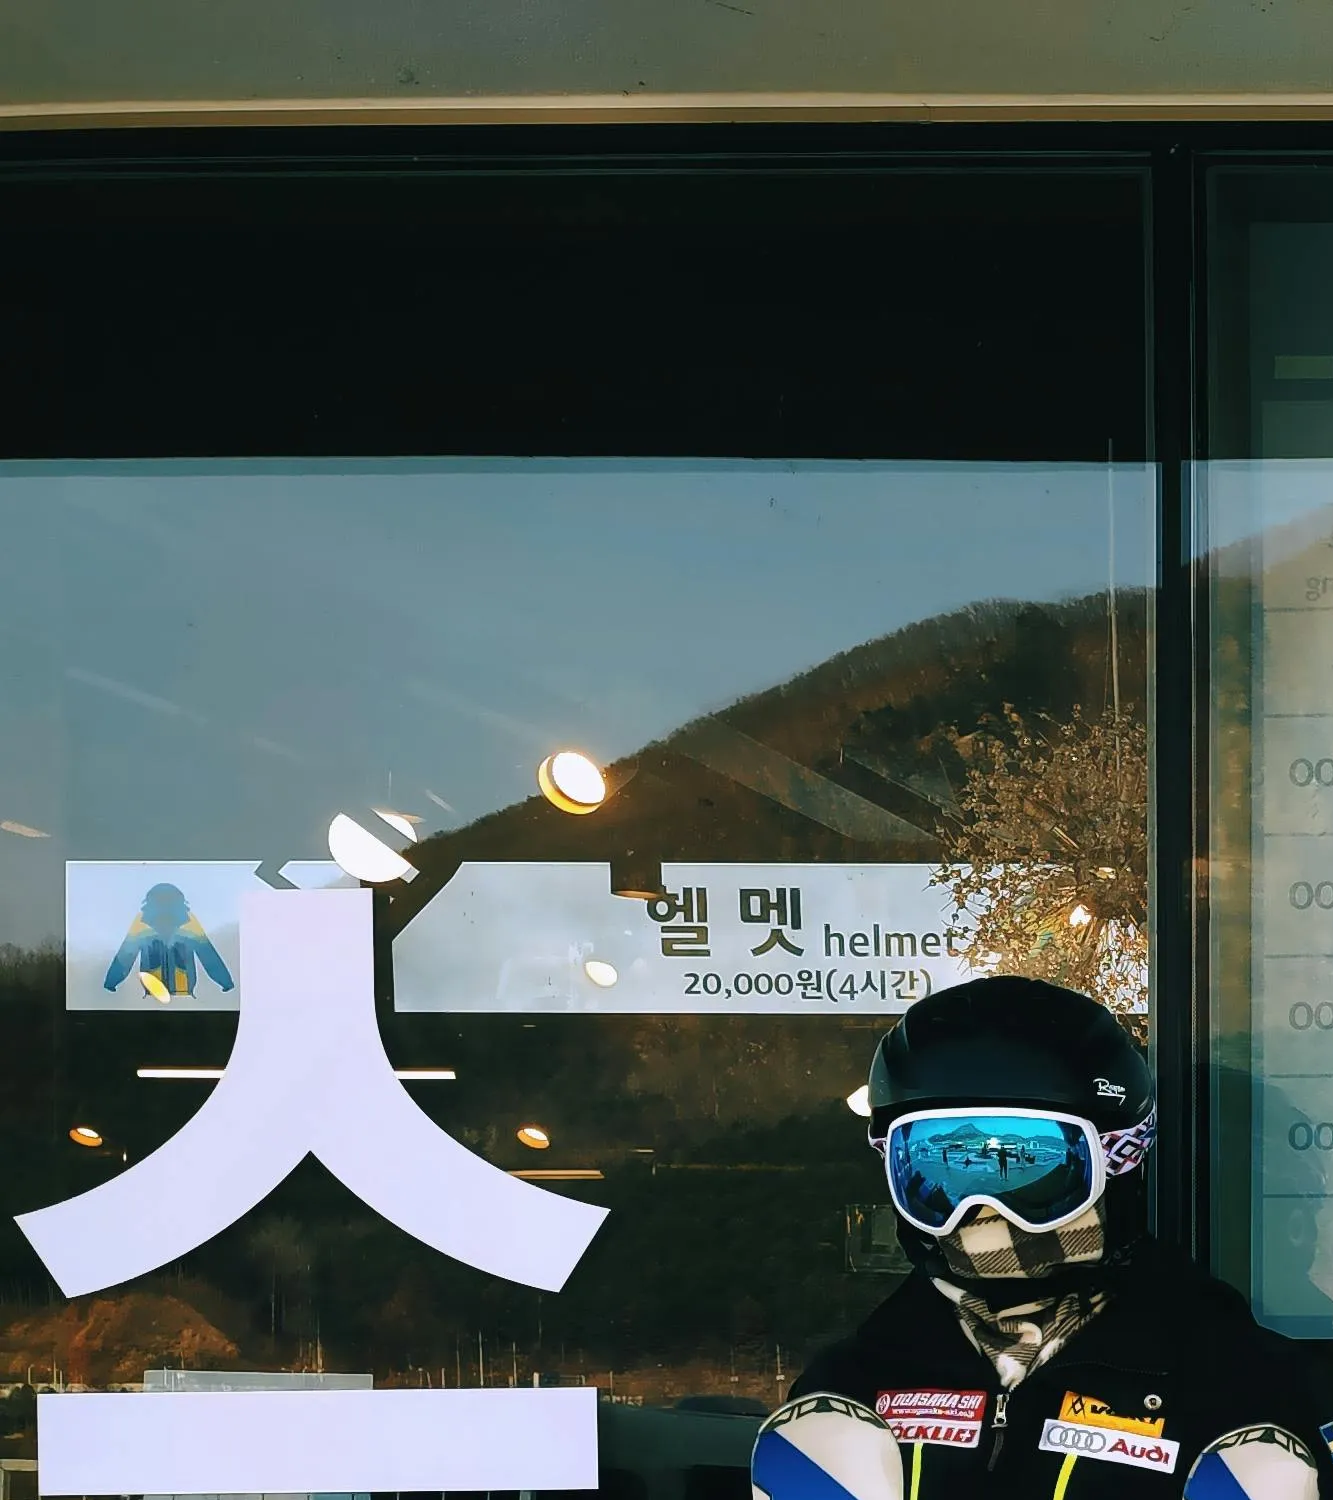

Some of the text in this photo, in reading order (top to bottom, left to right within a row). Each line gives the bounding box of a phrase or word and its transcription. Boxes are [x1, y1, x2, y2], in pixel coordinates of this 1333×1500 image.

[823, 923, 958, 958] helmet
[682, 969, 934, 1002] 20,000원(4시간)
[1107, 1437, 1171, 1466] Audi
